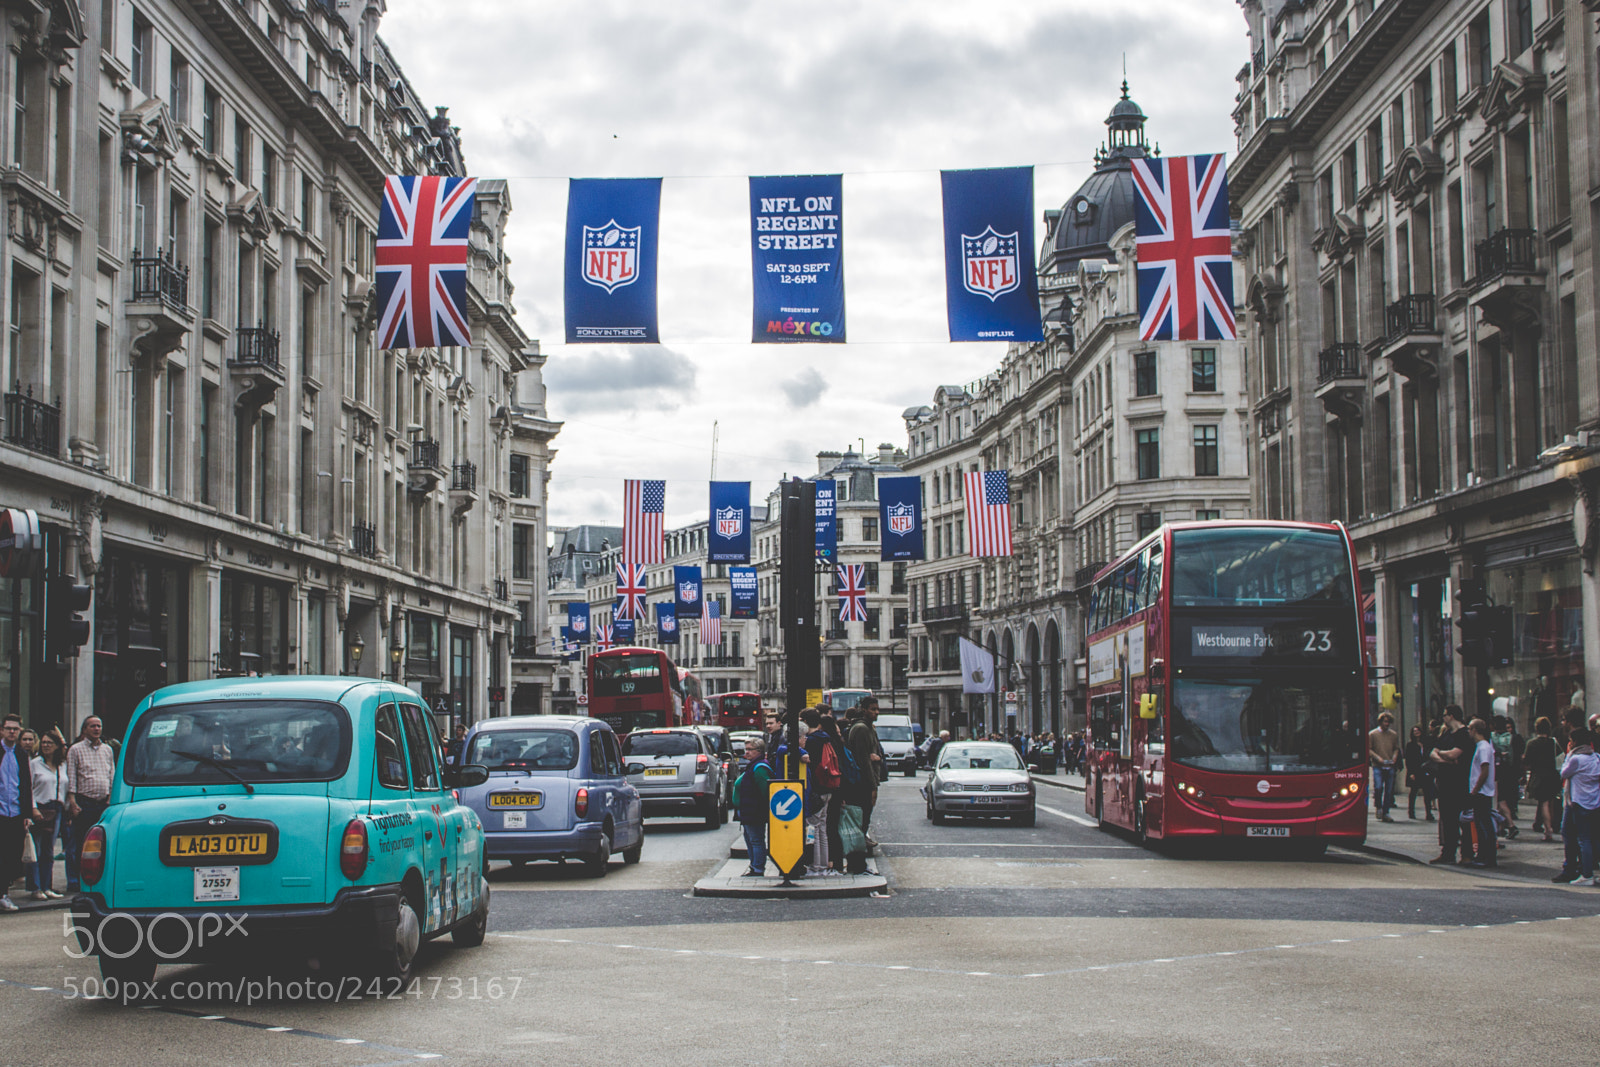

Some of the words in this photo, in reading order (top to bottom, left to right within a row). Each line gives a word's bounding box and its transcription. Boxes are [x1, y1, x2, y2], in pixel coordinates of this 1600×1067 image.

[761, 198, 800, 212] NFL
[804, 196, 833, 211] ON
[757, 215, 838, 231] REGENT
[758, 234, 837, 250] STREET
[590, 250, 632, 282] NFL
[766, 264, 786, 272] SAT
[788, 264, 801, 273] 30
[803, 263, 830, 272] SEPT
[780, 275, 817, 284] 12-6PM
[970, 258, 1013, 290] NFL
[720, 520, 739, 535] NFL
[891, 517, 911, 531] NFL
[682, 591, 695, 600] NFL
[1197, 632, 1251, 647] Westbourne
[1254, 633, 1274, 647] Park
[1303, 630, 1332, 652] 23
[621, 682, 635, 693] 139
[519, 796, 536, 804] CXF
[372, 811, 412, 835] rightmove
[176, 837, 221, 853] LA03
[226, 836, 260, 852] OTU
[379, 838, 390, 853] find
[390, 840, 401, 855] your
[401, 835, 414, 851] happy
[202, 878, 232, 888] 27557
